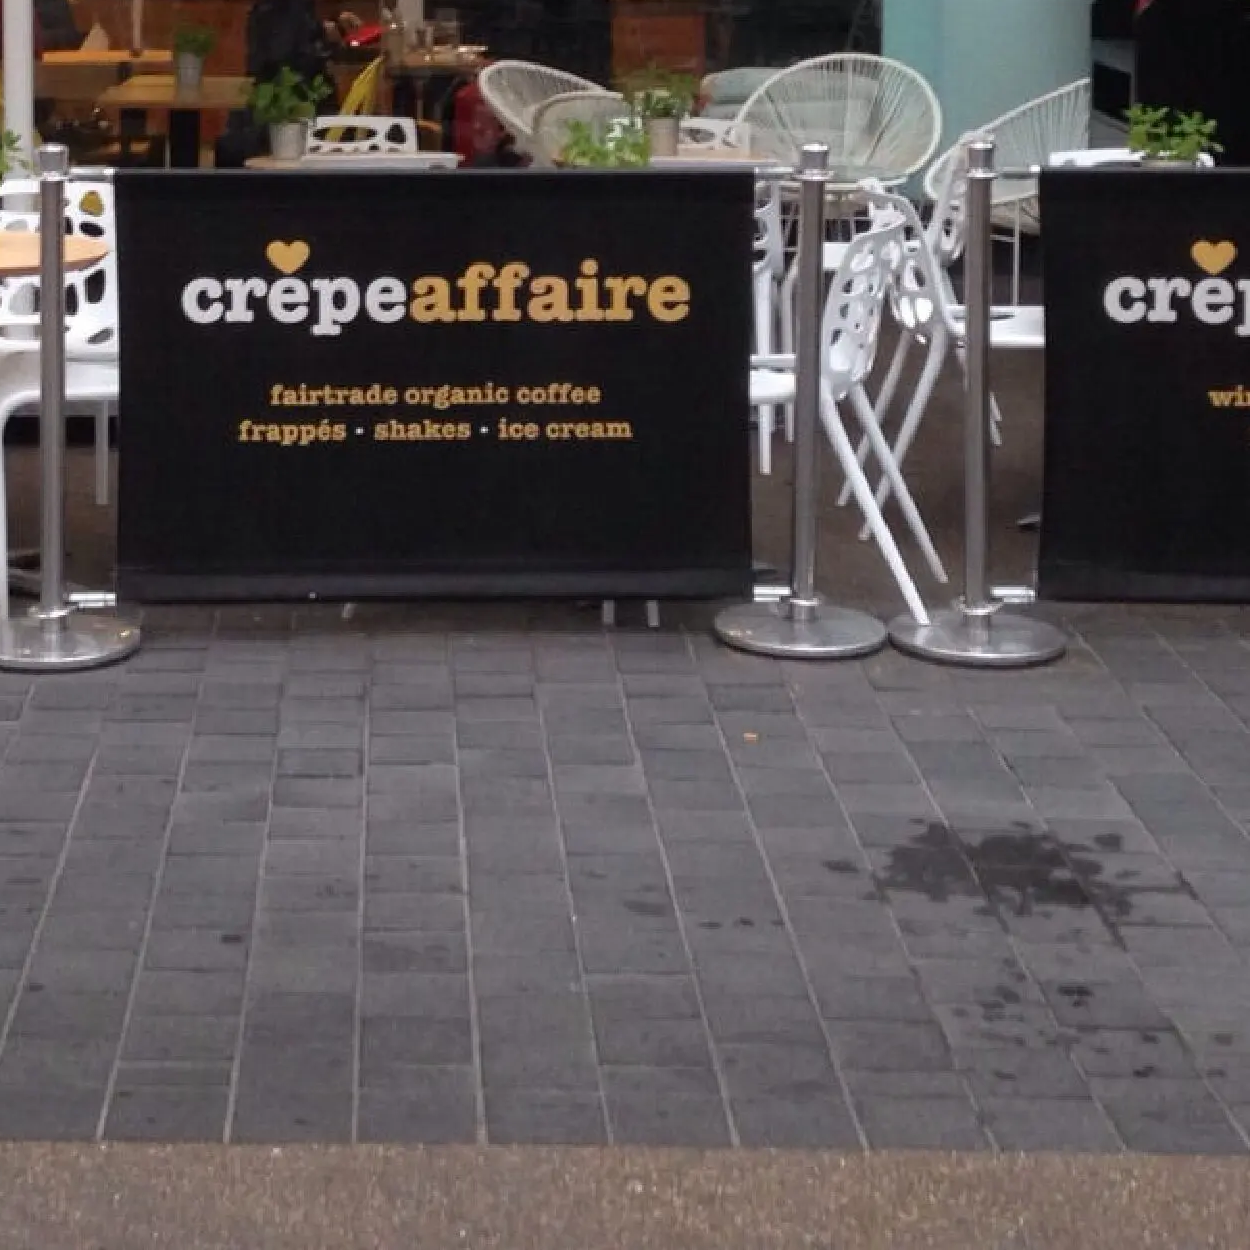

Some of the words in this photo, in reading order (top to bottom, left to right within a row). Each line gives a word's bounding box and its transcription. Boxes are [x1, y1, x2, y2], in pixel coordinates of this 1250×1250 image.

[270, 382, 398, 407] fairtrade
[404, 382, 510, 411] organic
[515, 382, 602, 406] coffee
[238, 418, 347, 447] frappés
[373, 418, 472, 441] shakes
[497, 417, 540, 441] ice
[545, 420, 633, 441] cream
